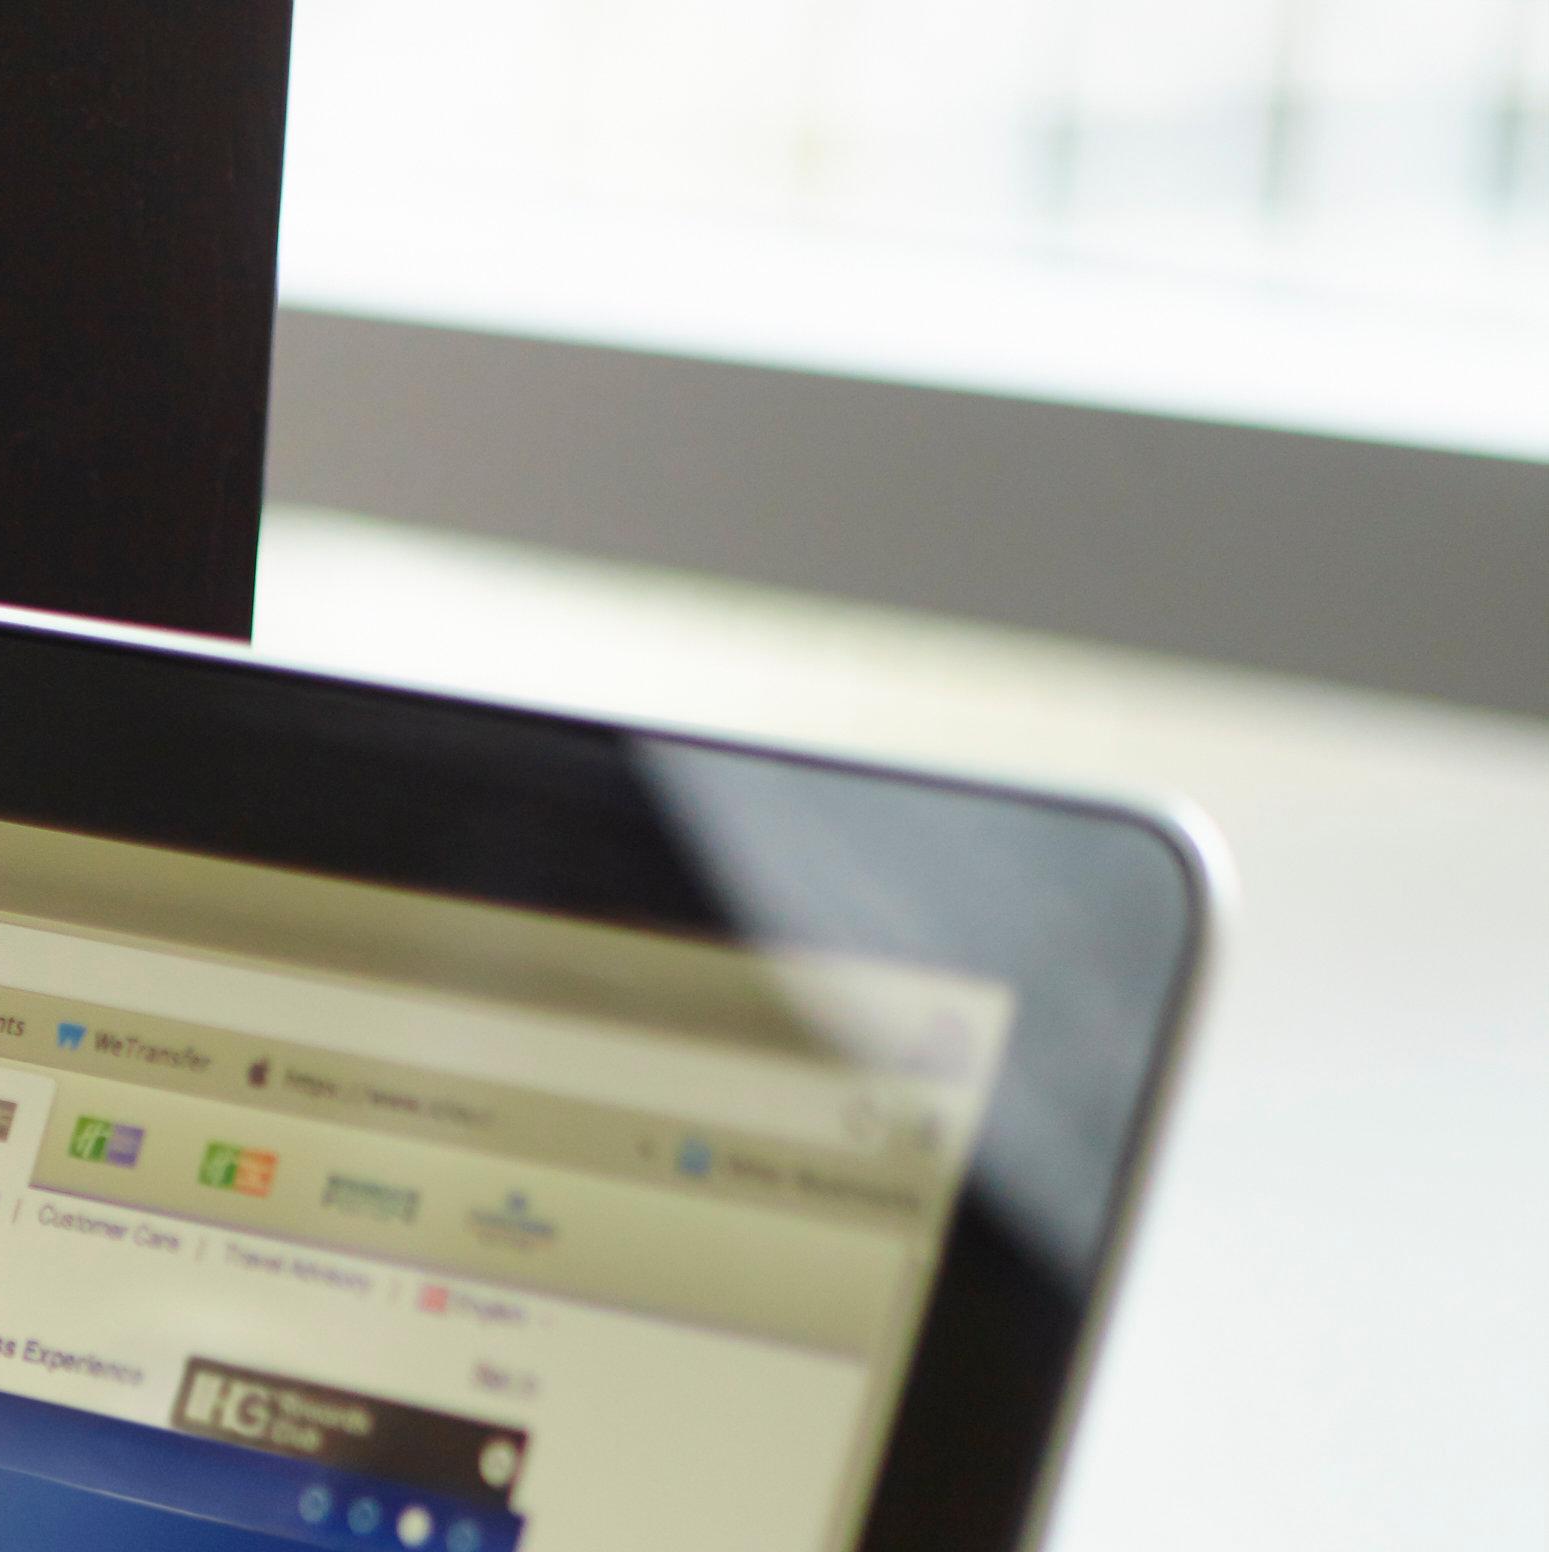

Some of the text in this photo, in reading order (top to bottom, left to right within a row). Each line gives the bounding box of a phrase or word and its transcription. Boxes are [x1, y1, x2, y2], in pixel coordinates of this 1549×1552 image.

[95, 1031, 212, 1072] WeTransfer
[38, 1204, 181, 1251] Customer Care
[22, 1339, 144, 1386] Experience
[185, 1368, 269, 1436] IHG
